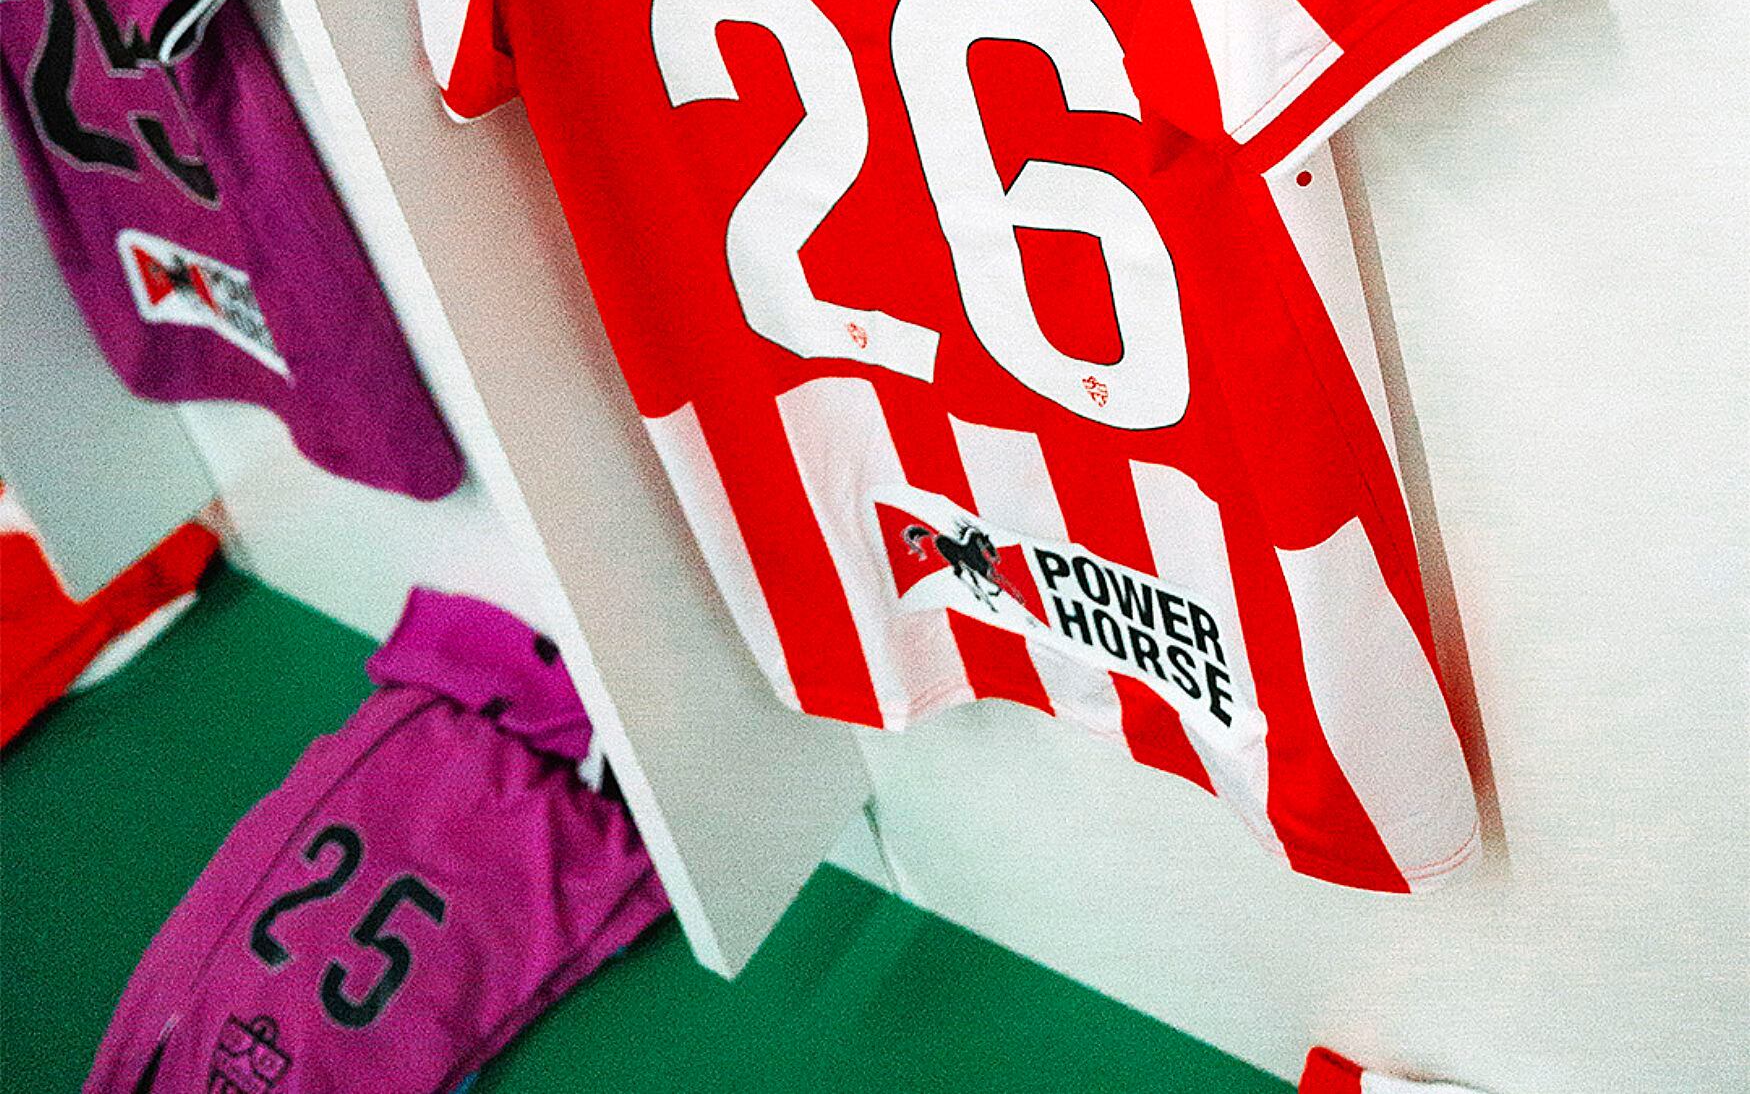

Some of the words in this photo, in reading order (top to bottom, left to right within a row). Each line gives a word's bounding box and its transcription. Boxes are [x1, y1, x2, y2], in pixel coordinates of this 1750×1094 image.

[1033, 546, 1227, 667] POWER
[1052, 595, 1234, 728] HORSE
[250, 824, 446, 1030] 25
